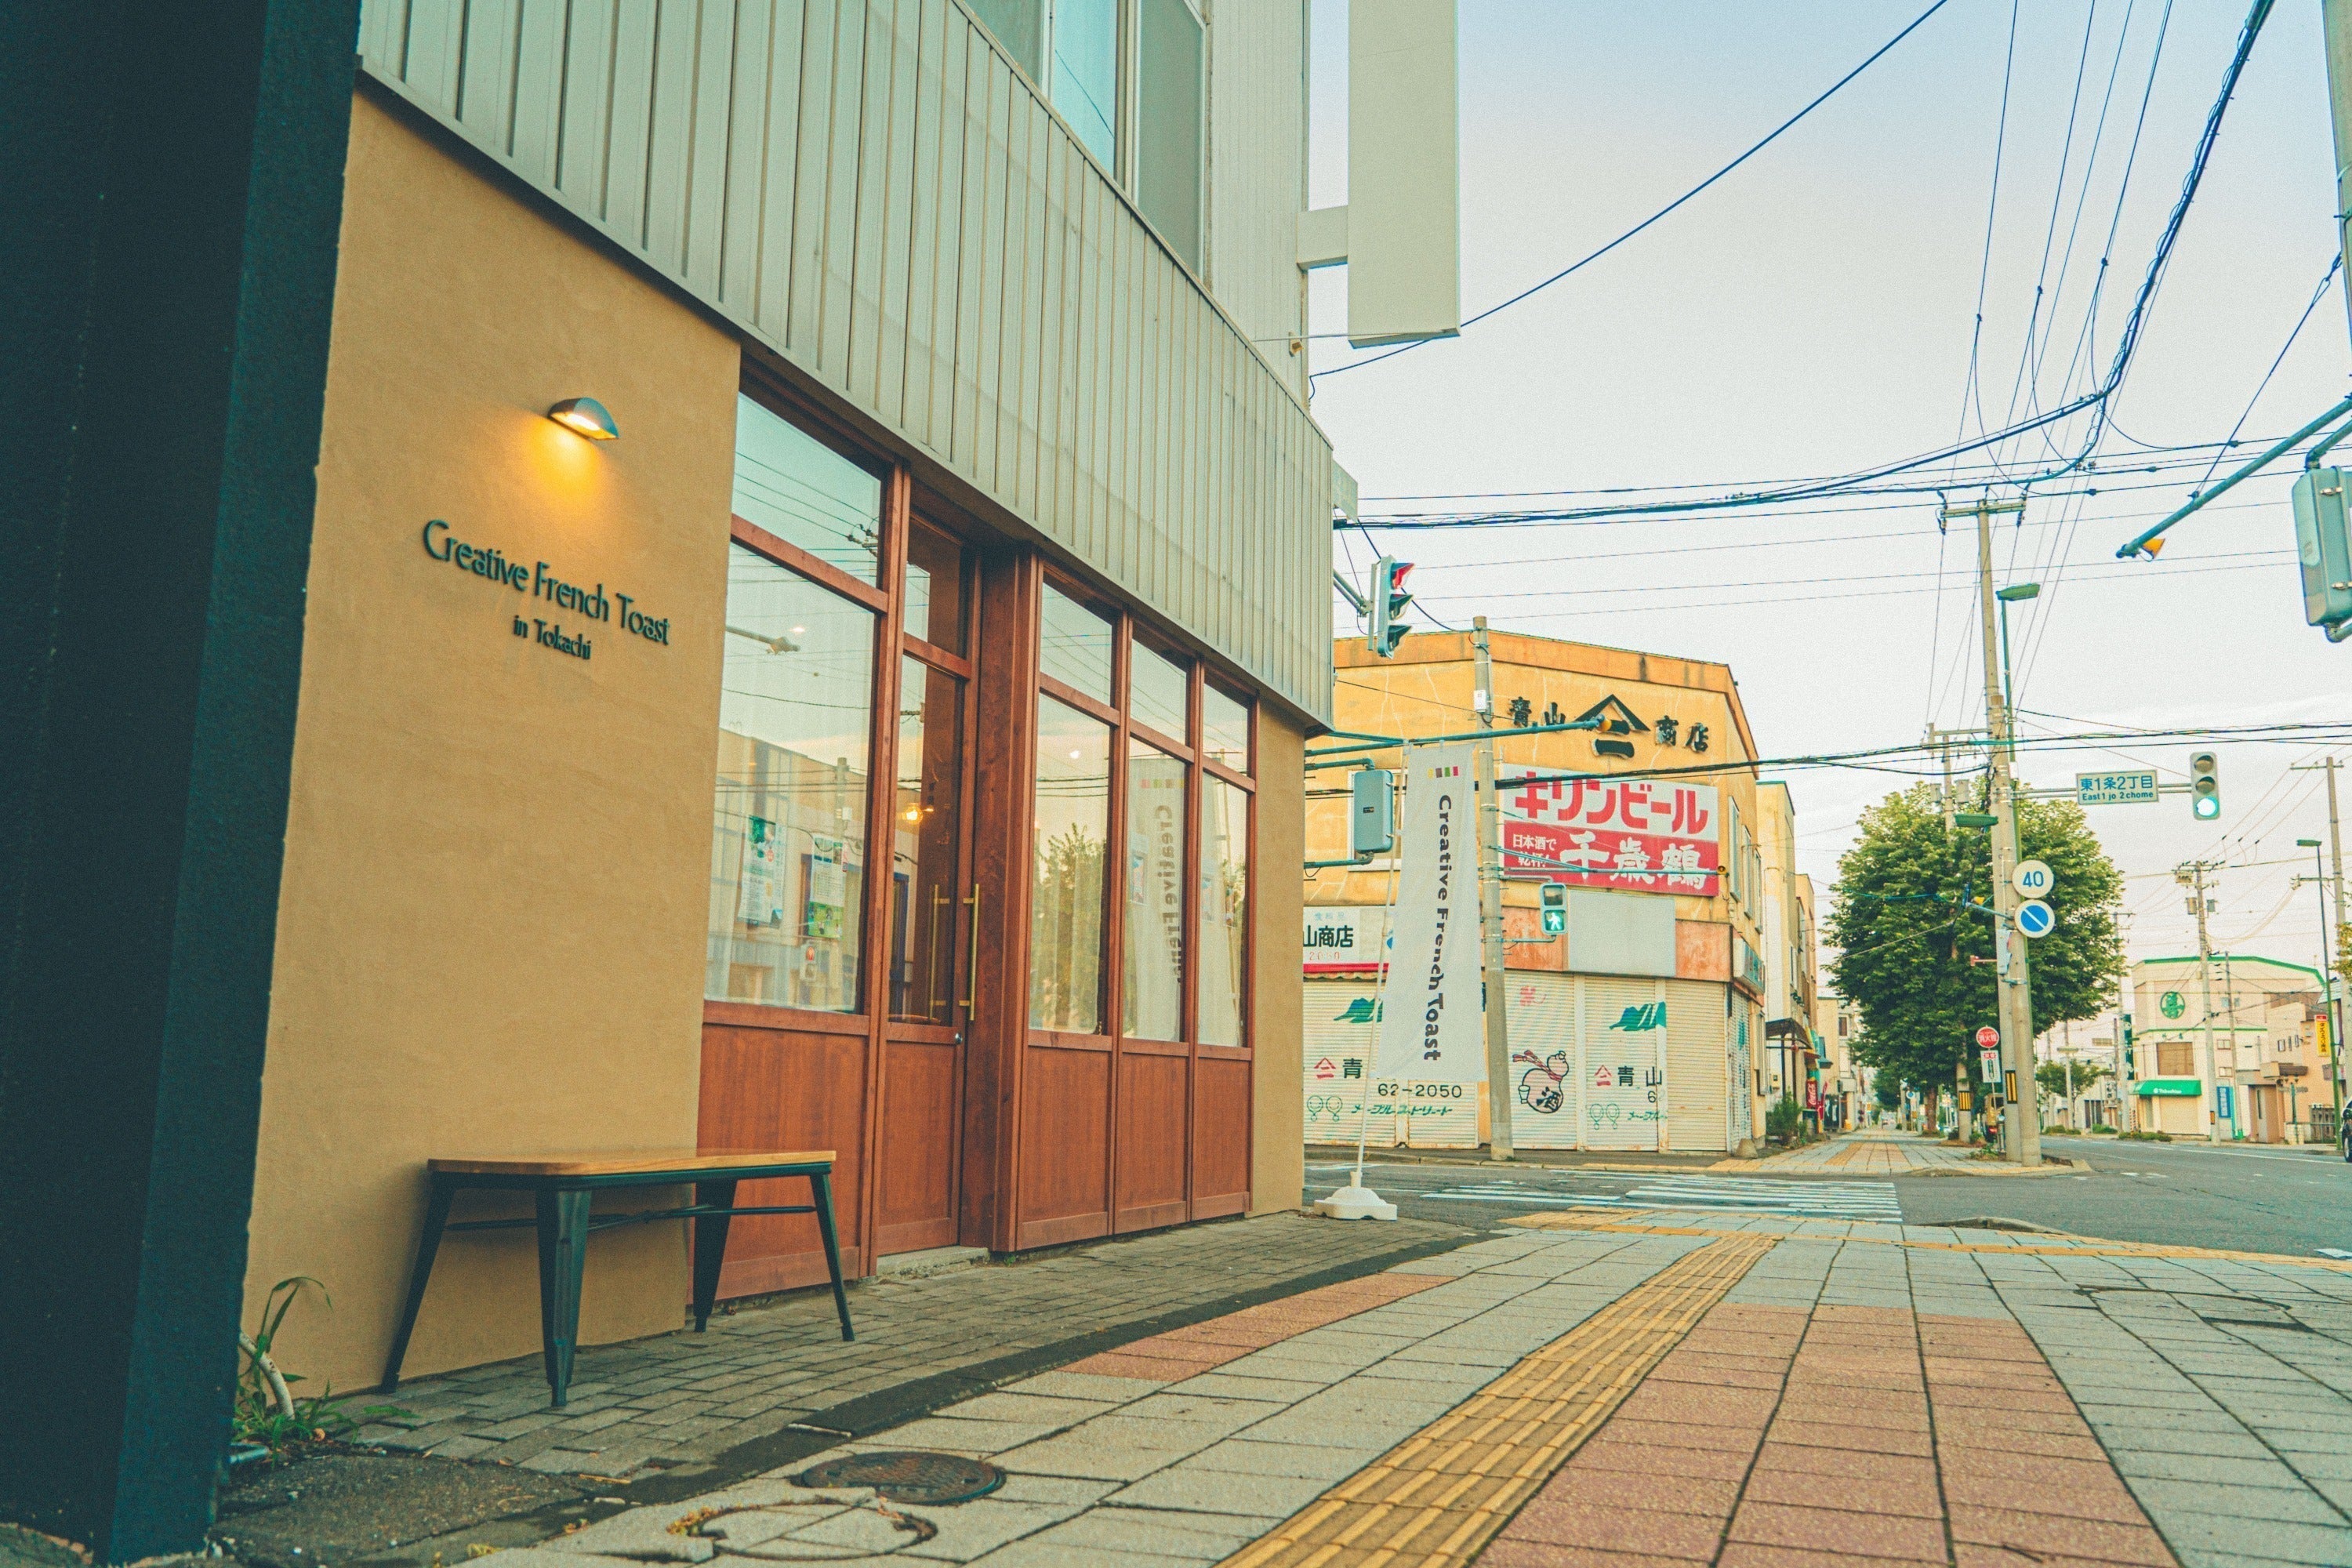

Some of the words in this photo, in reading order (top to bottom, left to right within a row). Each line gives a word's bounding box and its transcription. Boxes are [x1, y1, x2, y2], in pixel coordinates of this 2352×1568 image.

[423, 519, 530, 591] Creative
[534, 561, 610, 622] French
[615, 592, 671, 645] Toast
[514, 615, 528, 638] in
[534, 619, 592, 660] Tokachi
[1654, 715, 1710, 753] 商店
[1515, 771, 1709, 835] キリンビール
[2080, 775, 2154, 792] 東1条2丁目
[2108, 792, 2117, 800] jo
[2126, 790, 2154, 799] chome
[1437, 794, 1452, 902] Creative
[1513, 833, 1557, 851] 日本酒で
[1559, 830, 1711, 890] 千歳鶴
[2023, 870, 2044, 887] 40
[1428, 907, 1449, 990] French
[1424, 993, 1444, 1061] Toast
[1377, 1083, 1462, 1098] 62-2050
